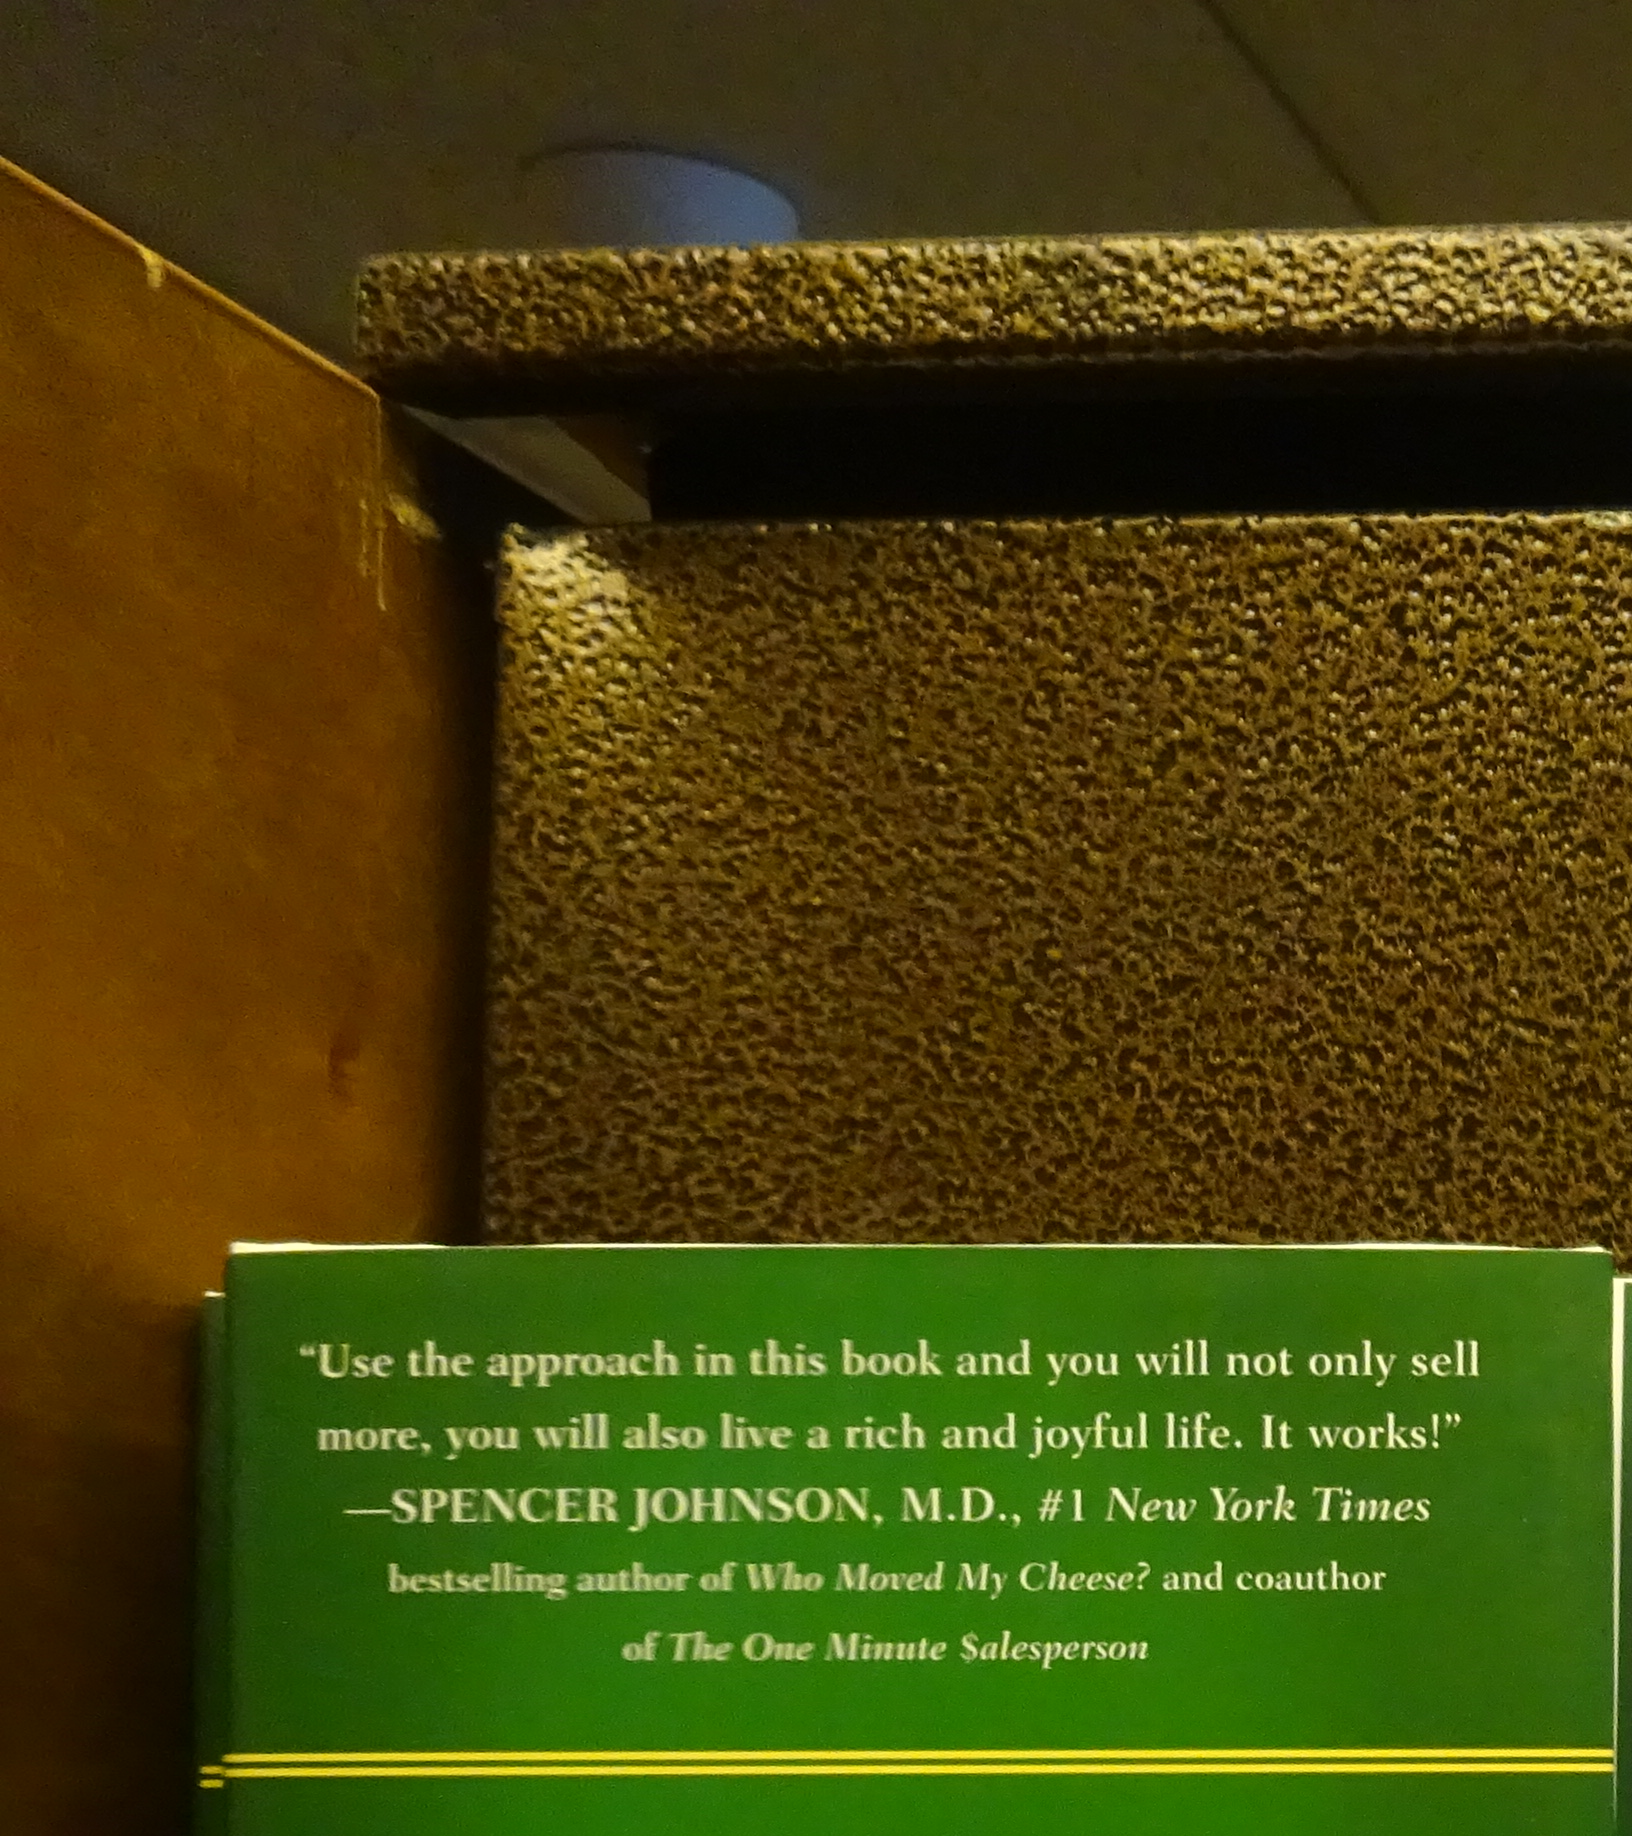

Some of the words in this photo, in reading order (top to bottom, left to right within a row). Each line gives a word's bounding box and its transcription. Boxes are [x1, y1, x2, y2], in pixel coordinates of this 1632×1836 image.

[407, 1340, 474, 1377] the
[486, 1339, 680, 1388] approach
[694, 1343, 735, 1376] in
[749, 1338, 828, 1376] this
[841, 1338, 942, 1376] book
[956, 1338, 1030, 1376] and
[1046, 1353, 1118, 1386] you
[1135, 1339, 1209, 1376] will
[1227, 1349, 1291, 1376] not
[1308, 1339, 1396, 1387] only
[1411, 1339, 1479, 1377] sell
[318, 1427, 432, 1453] more,
[445, 1427, 519, 1461] you
[533, 1412, 609, 1450] will
[622, 1412, 707, 1450] also
[721, 1412, 793, 1450] live
[806, 1426, 830, 1449] a
[845, 1412, 926, 1449] rich
[941, 1412, 1016, 1449] and
[1028, 1411, 1148, 1459] joyful
[1166, 1411, 1243, 1449] life.
[1262, 1414, 1292, 1449] It
[628, 1487, 884, 1532] JOHNSON,
[903, 1487, 1021, 1525] M.D.,
[1039, 1489, 1083, 1522] #1
[1107, 1487, 1197, 1522] New
[1211, 1484, 1296, 1521] York
[1313, 1486, 1430, 1522] Times
[389, 1561, 568, 1601] bestselling
[576, 1561, 691, 1592] author
[699, 1561, 738, 1592] of
[746, 1561, 825, 1592] Who
[835, 1560, 944, 1592] Moved
[955, 1561, 1003, 1600] My
[1019, 1560, 1151, 1592] Cheese?
[1162, 1560, 1223, 1591] and
[1236, 1560, 1386, 1591] coauthor
[621, 1631, 661, 1661] of
[669, 1630, 734, 1662] The
[741, 1632, 815, 1662] One
[825, 1632, 947, 1661] Minute
